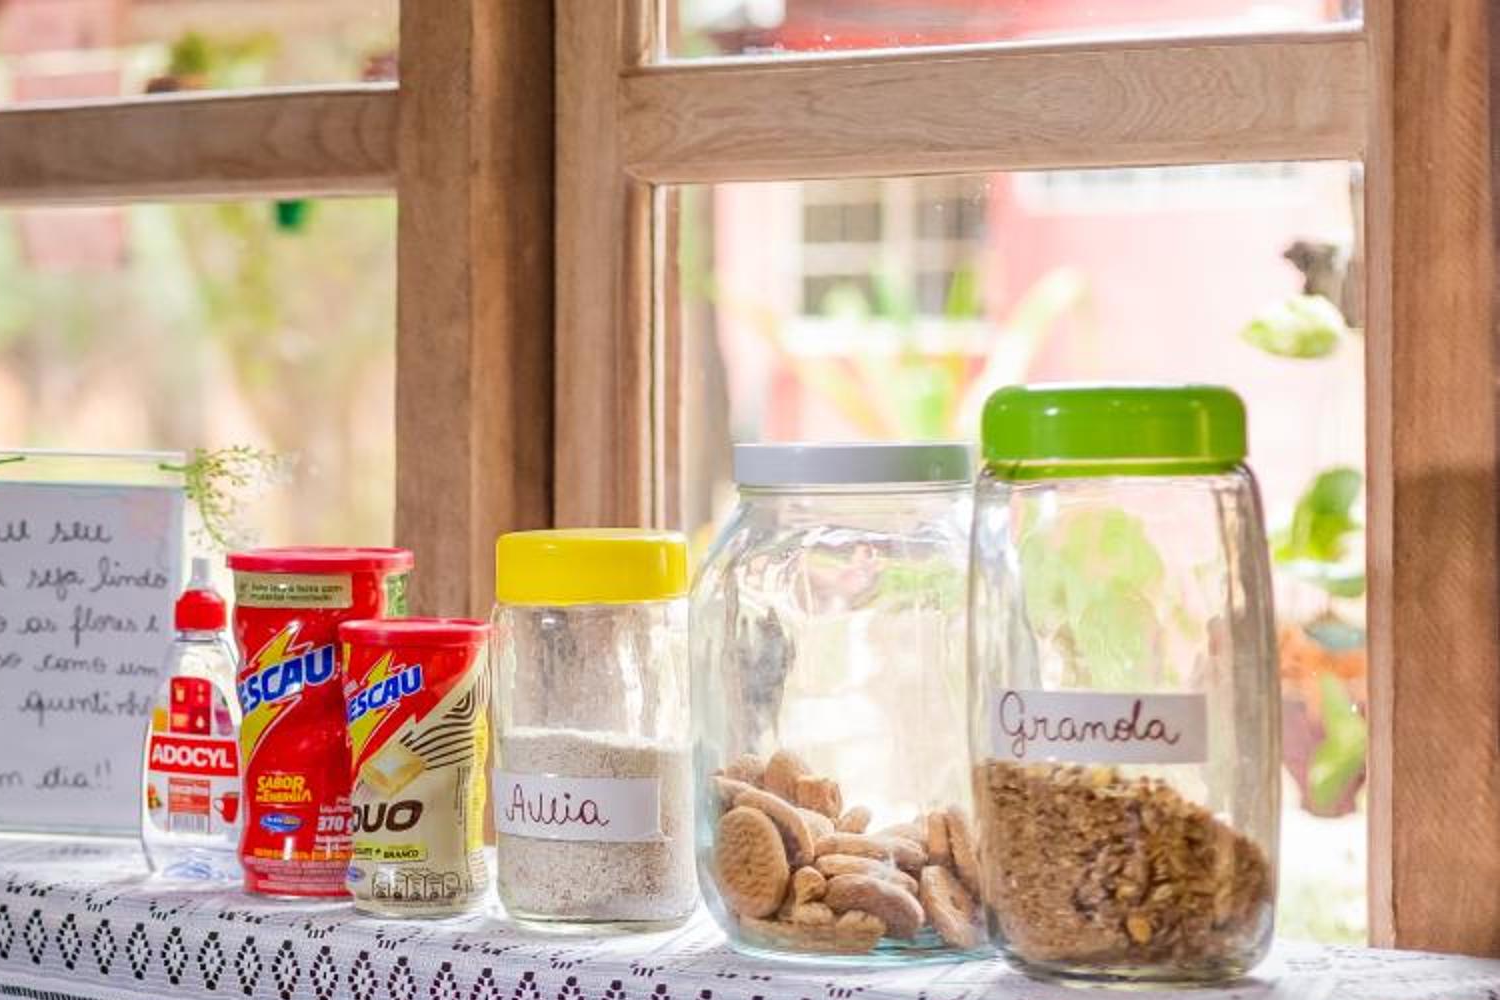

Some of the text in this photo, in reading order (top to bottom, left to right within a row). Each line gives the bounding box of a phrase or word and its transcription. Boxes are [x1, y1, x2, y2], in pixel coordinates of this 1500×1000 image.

[49, 519, 113, 545] seu
[25, 566, 85, 602] seja
[89, 555, 169, 594] lindo
[17, 615, 57, 634] as
[69, 604, 138, 649] flores
[33, 653, 107, 673] como
[115, 661, 160, 677] um
[1000, 690, 1182, 758] Granola
[151, 743, 235, 769] ADOCYL
